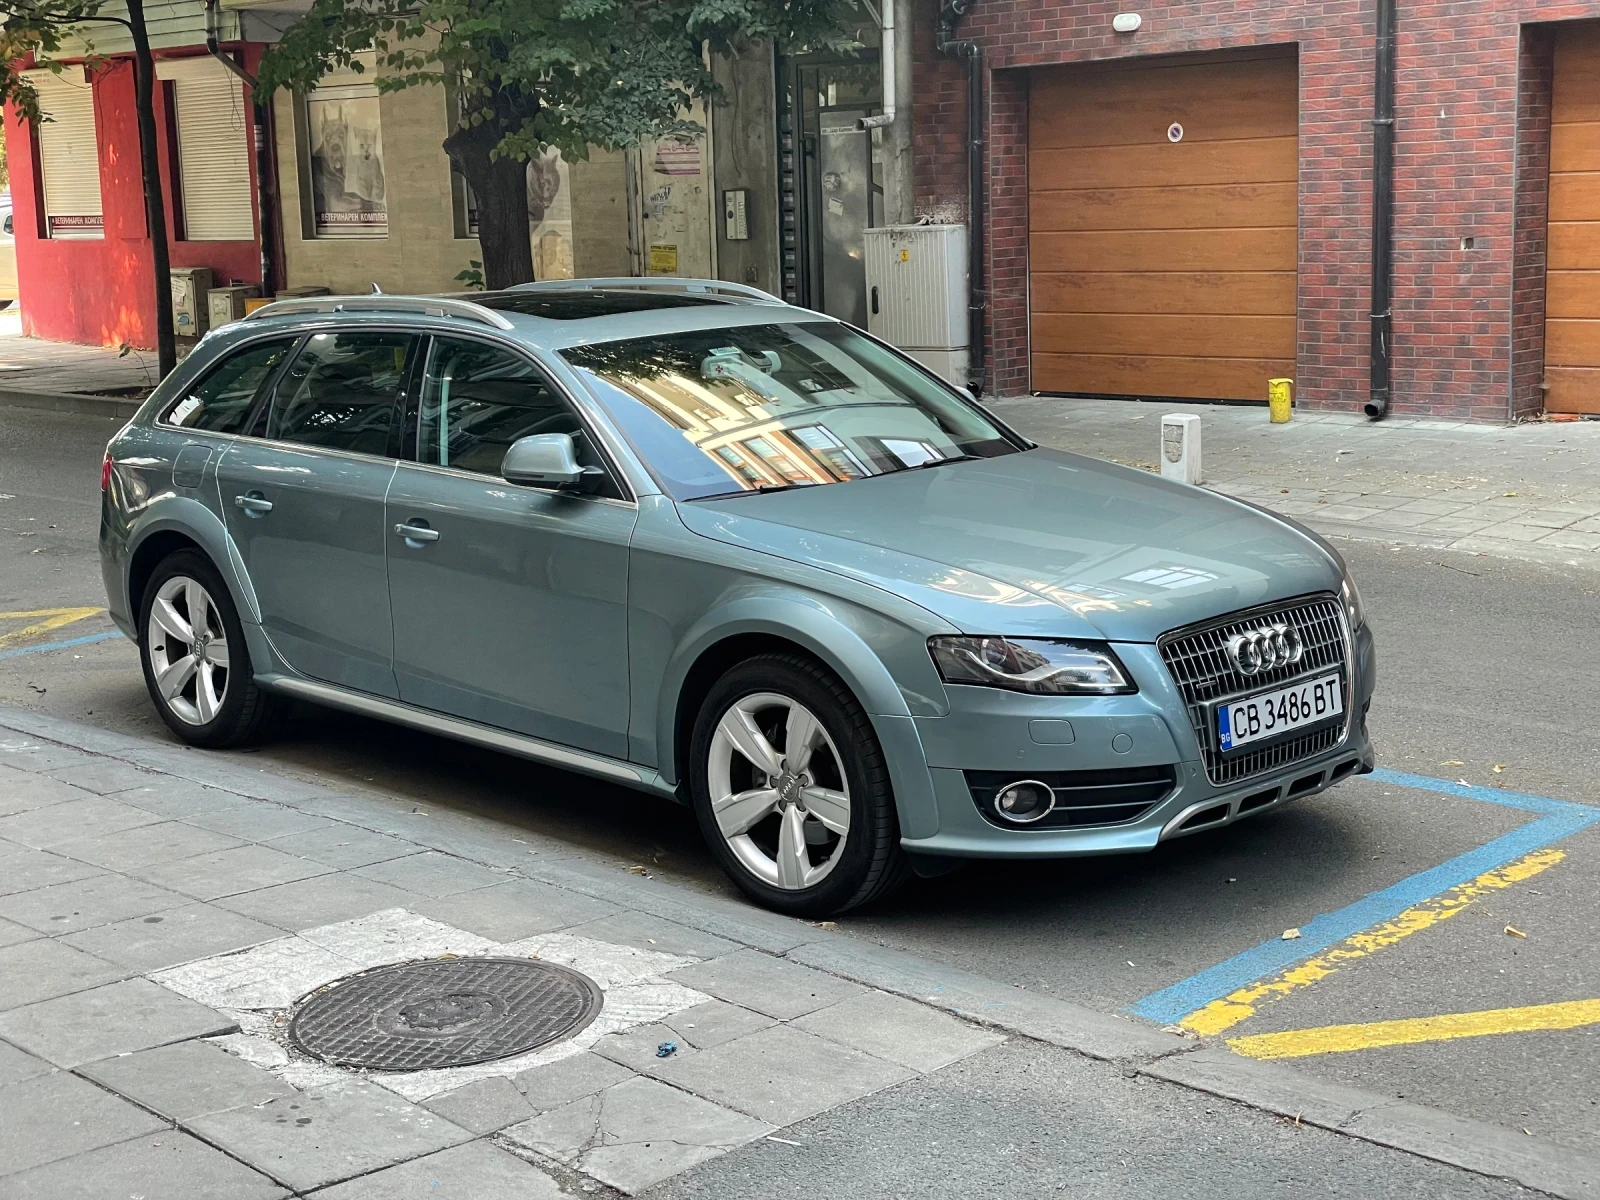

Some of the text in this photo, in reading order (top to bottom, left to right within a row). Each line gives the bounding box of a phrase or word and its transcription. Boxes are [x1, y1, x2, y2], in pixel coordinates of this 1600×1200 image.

[321, 213, 358, 222] ВЕТЕРИНАРЕН
[1233, 679, 1337, 739] CB 3486 BT
[1220, 732, 1231, 744] BG
